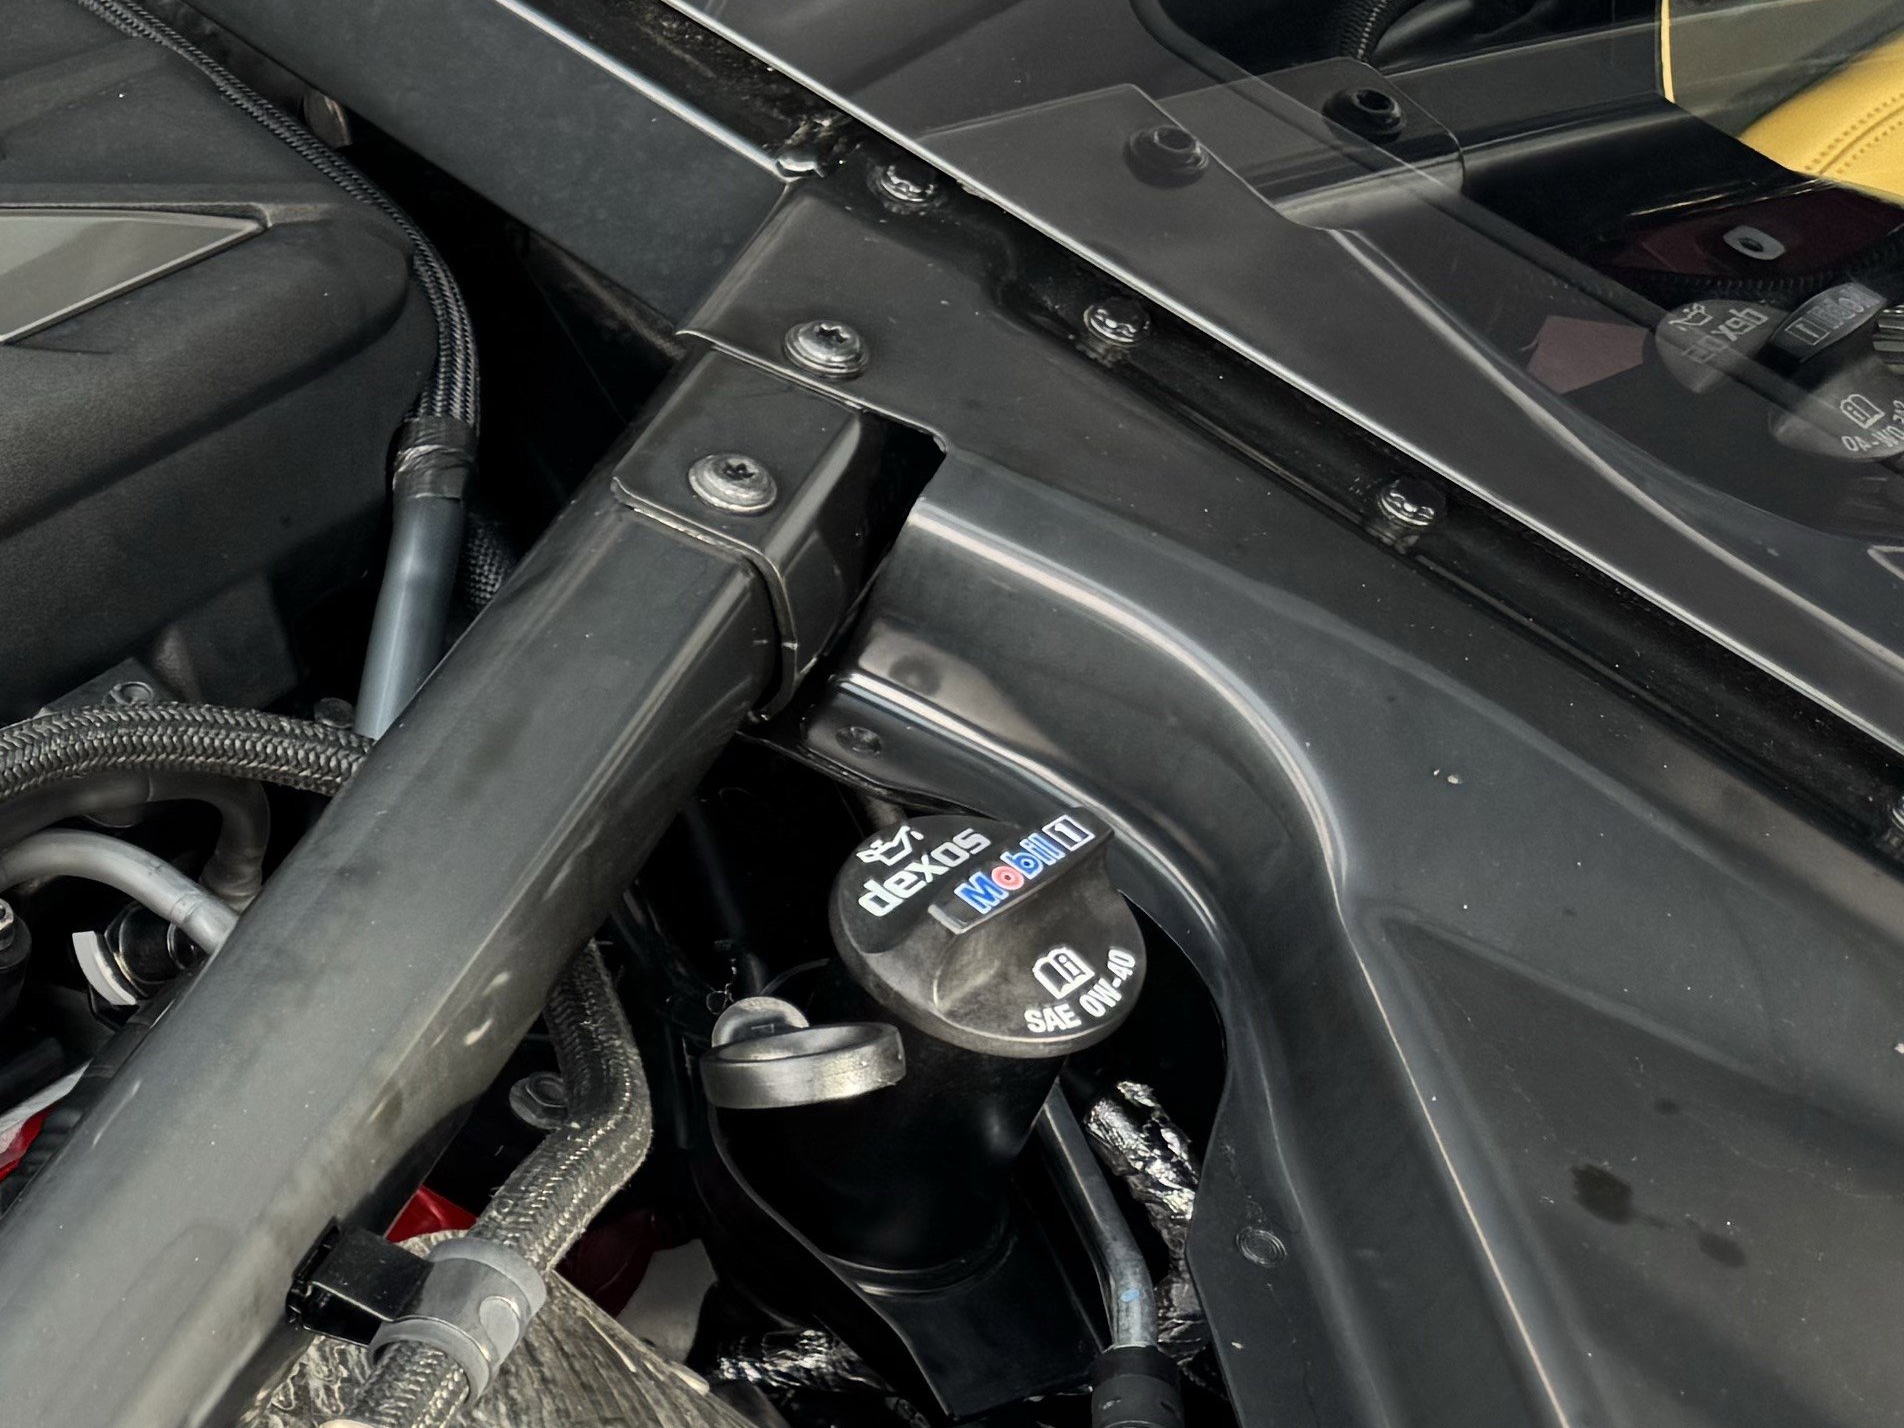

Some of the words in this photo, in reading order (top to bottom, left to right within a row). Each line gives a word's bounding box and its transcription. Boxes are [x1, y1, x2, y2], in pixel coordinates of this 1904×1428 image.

[857, 827, 992, 918] dexos
[953, 831, 1066, 915] Mobil
[1023, 1002, 1082, 1033] SAE
[1078, 949, 1136, 1018] 0W-40
